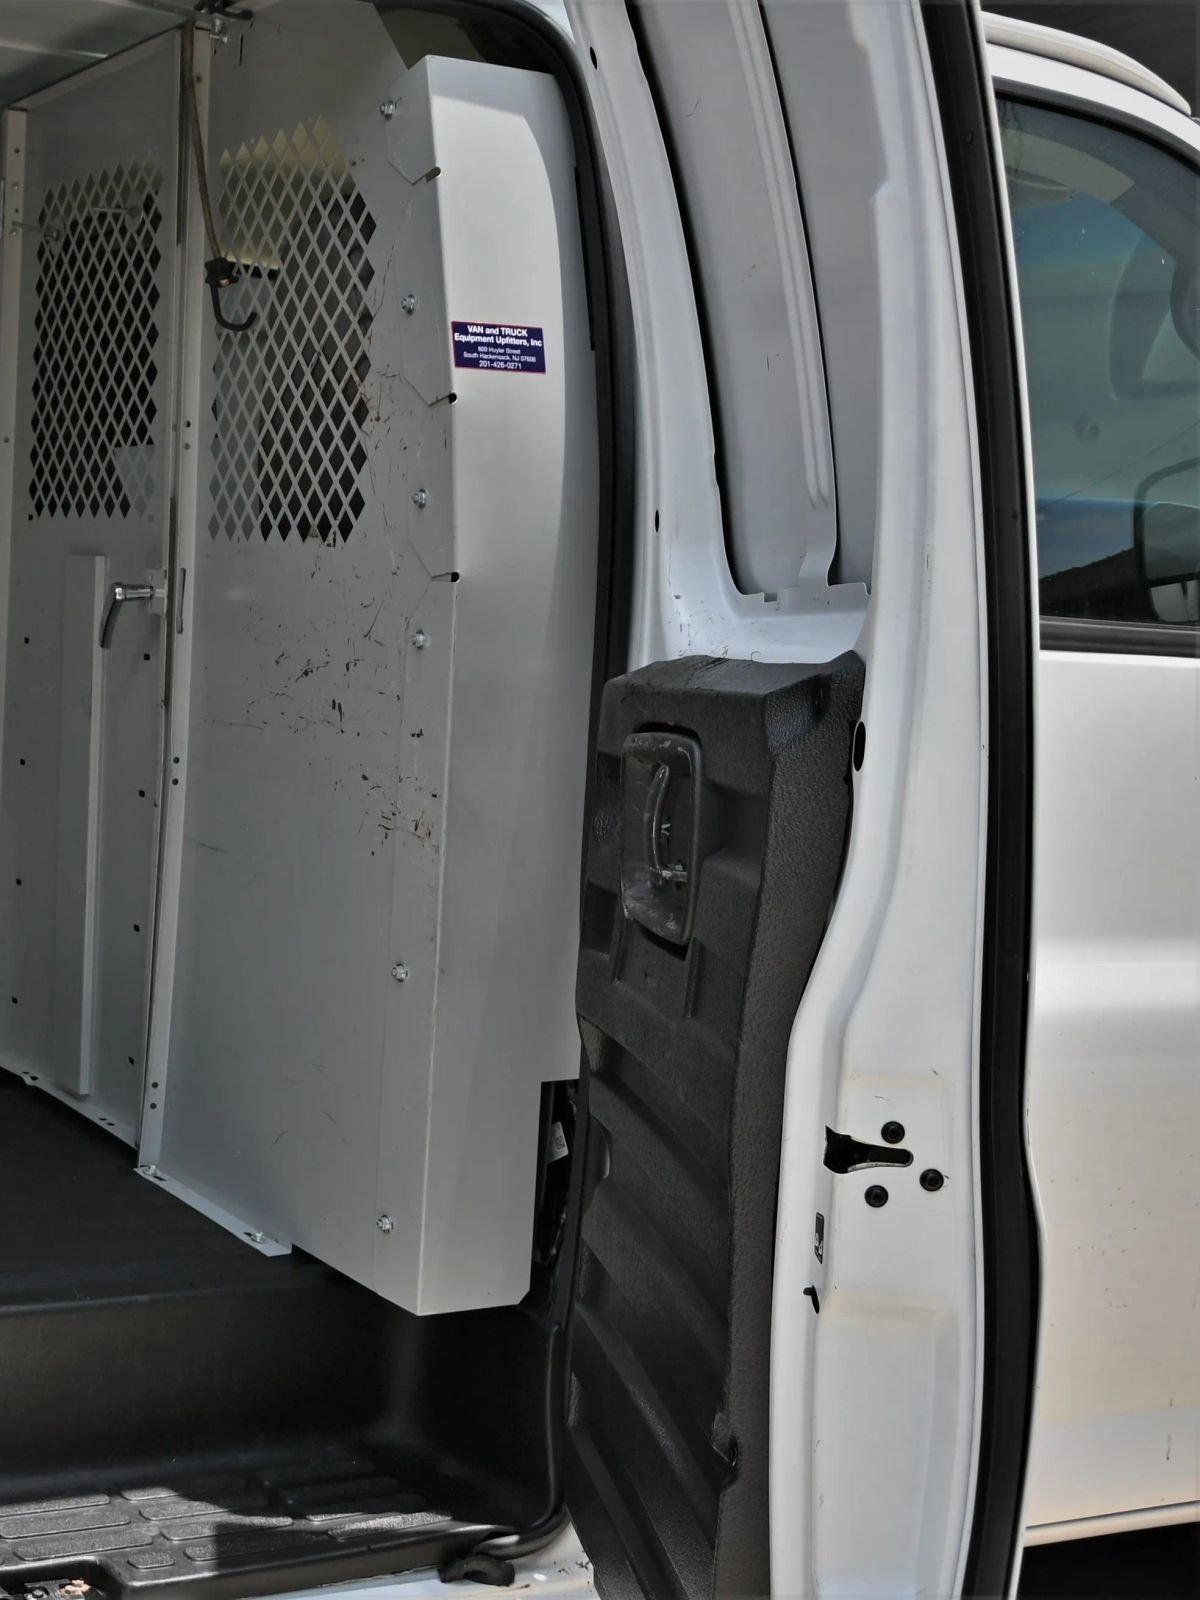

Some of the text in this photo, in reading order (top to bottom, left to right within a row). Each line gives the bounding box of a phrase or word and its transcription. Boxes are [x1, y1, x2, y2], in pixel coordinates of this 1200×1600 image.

[467, 325, 528, 337] VAN and TRUCK
[454, 333, 543, 347] Equipment Upfitters, Inc
[479, 353, 511, 361] Hackensack,
[479, 360, 522, 369] 201-426-0271
